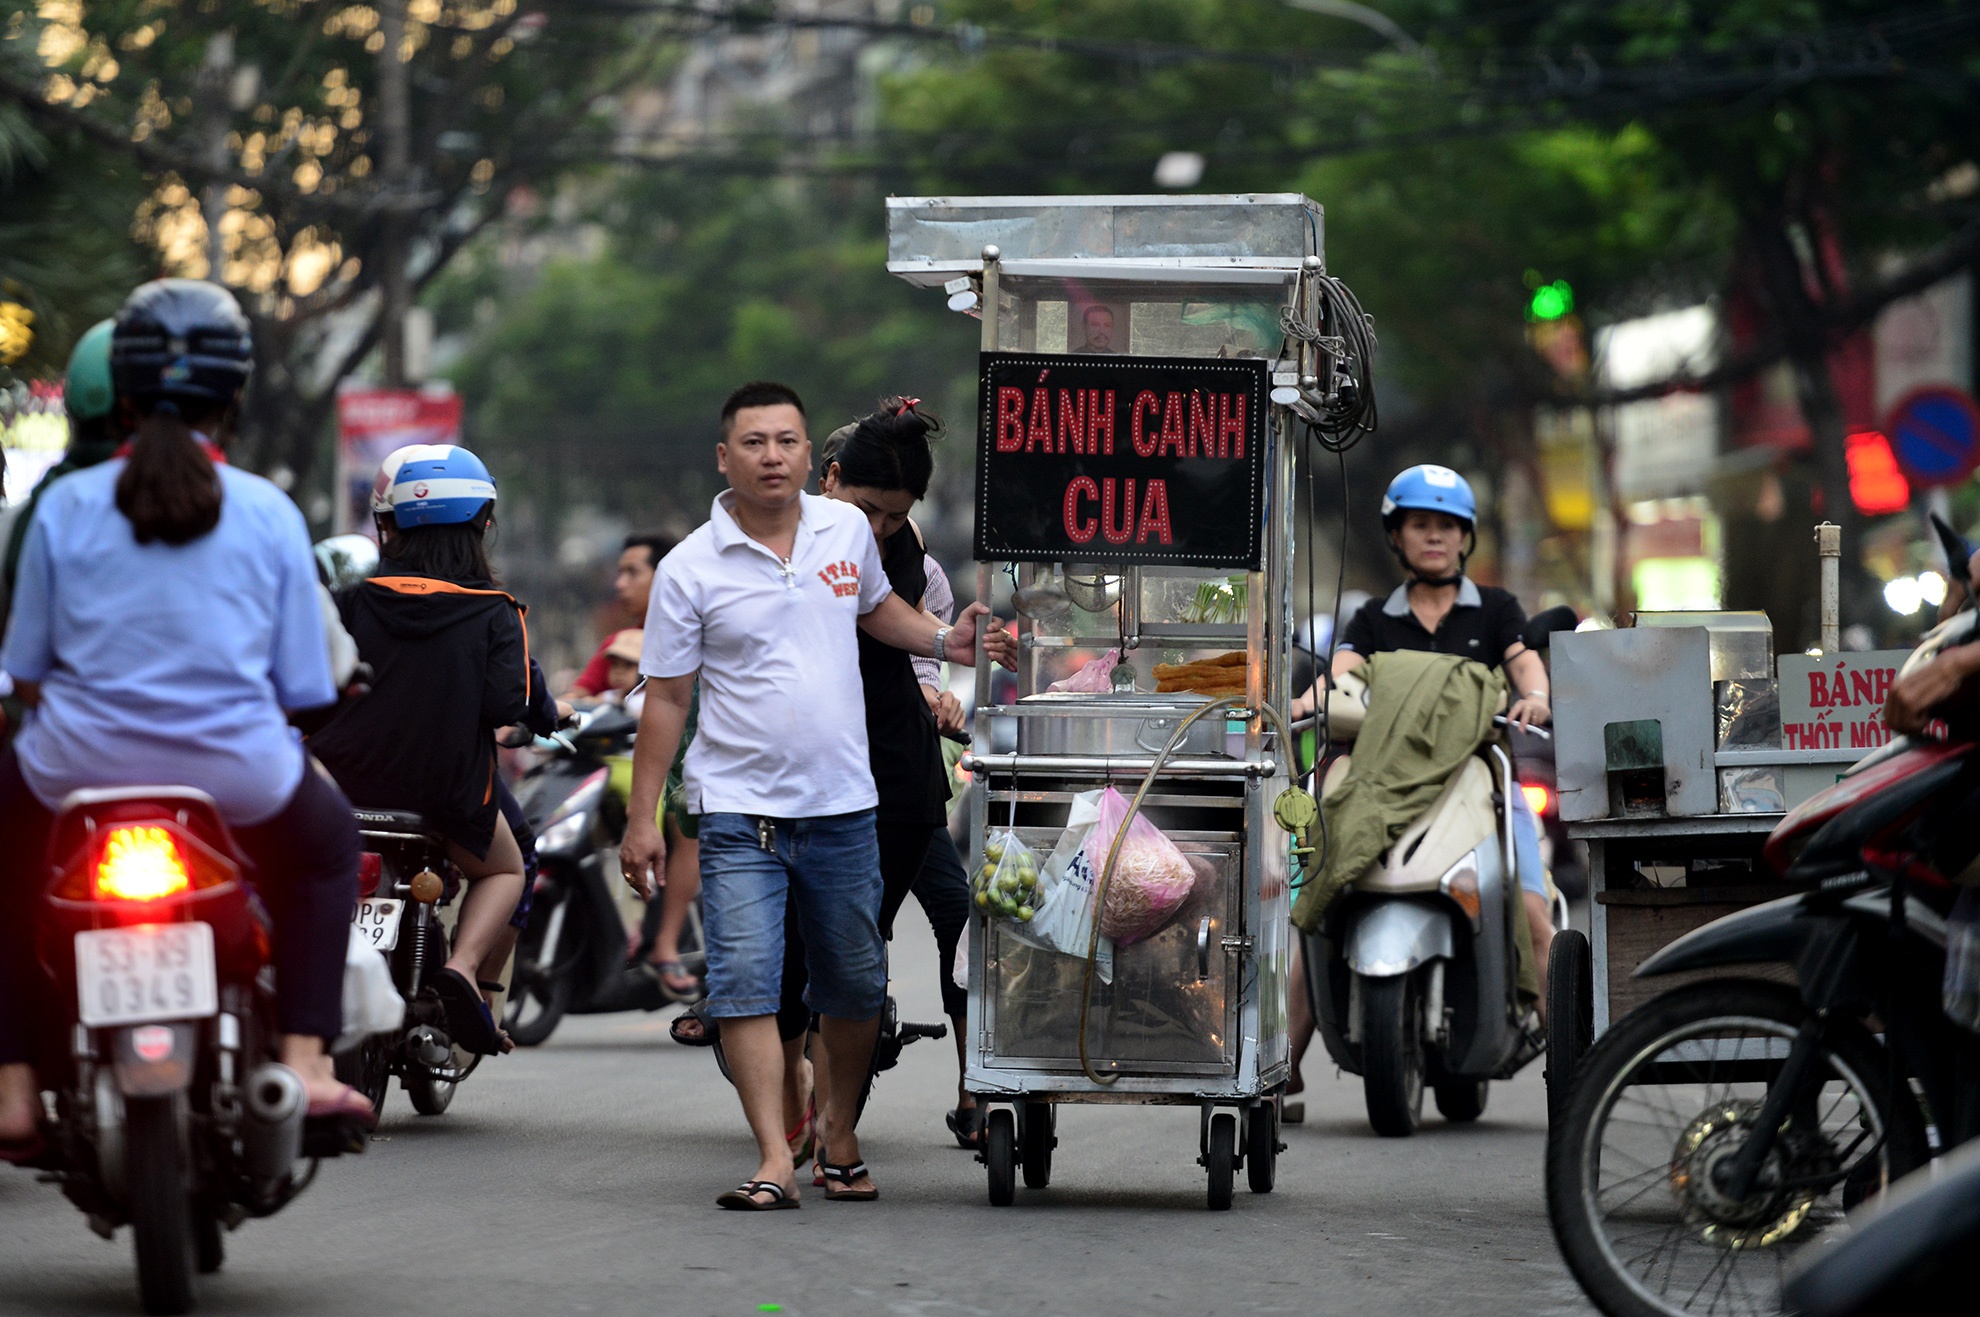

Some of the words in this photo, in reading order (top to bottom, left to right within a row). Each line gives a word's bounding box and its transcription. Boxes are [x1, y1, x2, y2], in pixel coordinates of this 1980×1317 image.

[996, 369, 1116, 455] BÁNH
[1131, 390, 1247, 459] CANH
[1063, 476, 1173, 544] CUA
[1807, 661, 1897, 707] BÁNH
[1784, 709, 1843, 750] THỐT
[1850, 708, 1891, 749] NỐT
[353, 813, 396, 822] ONDA
